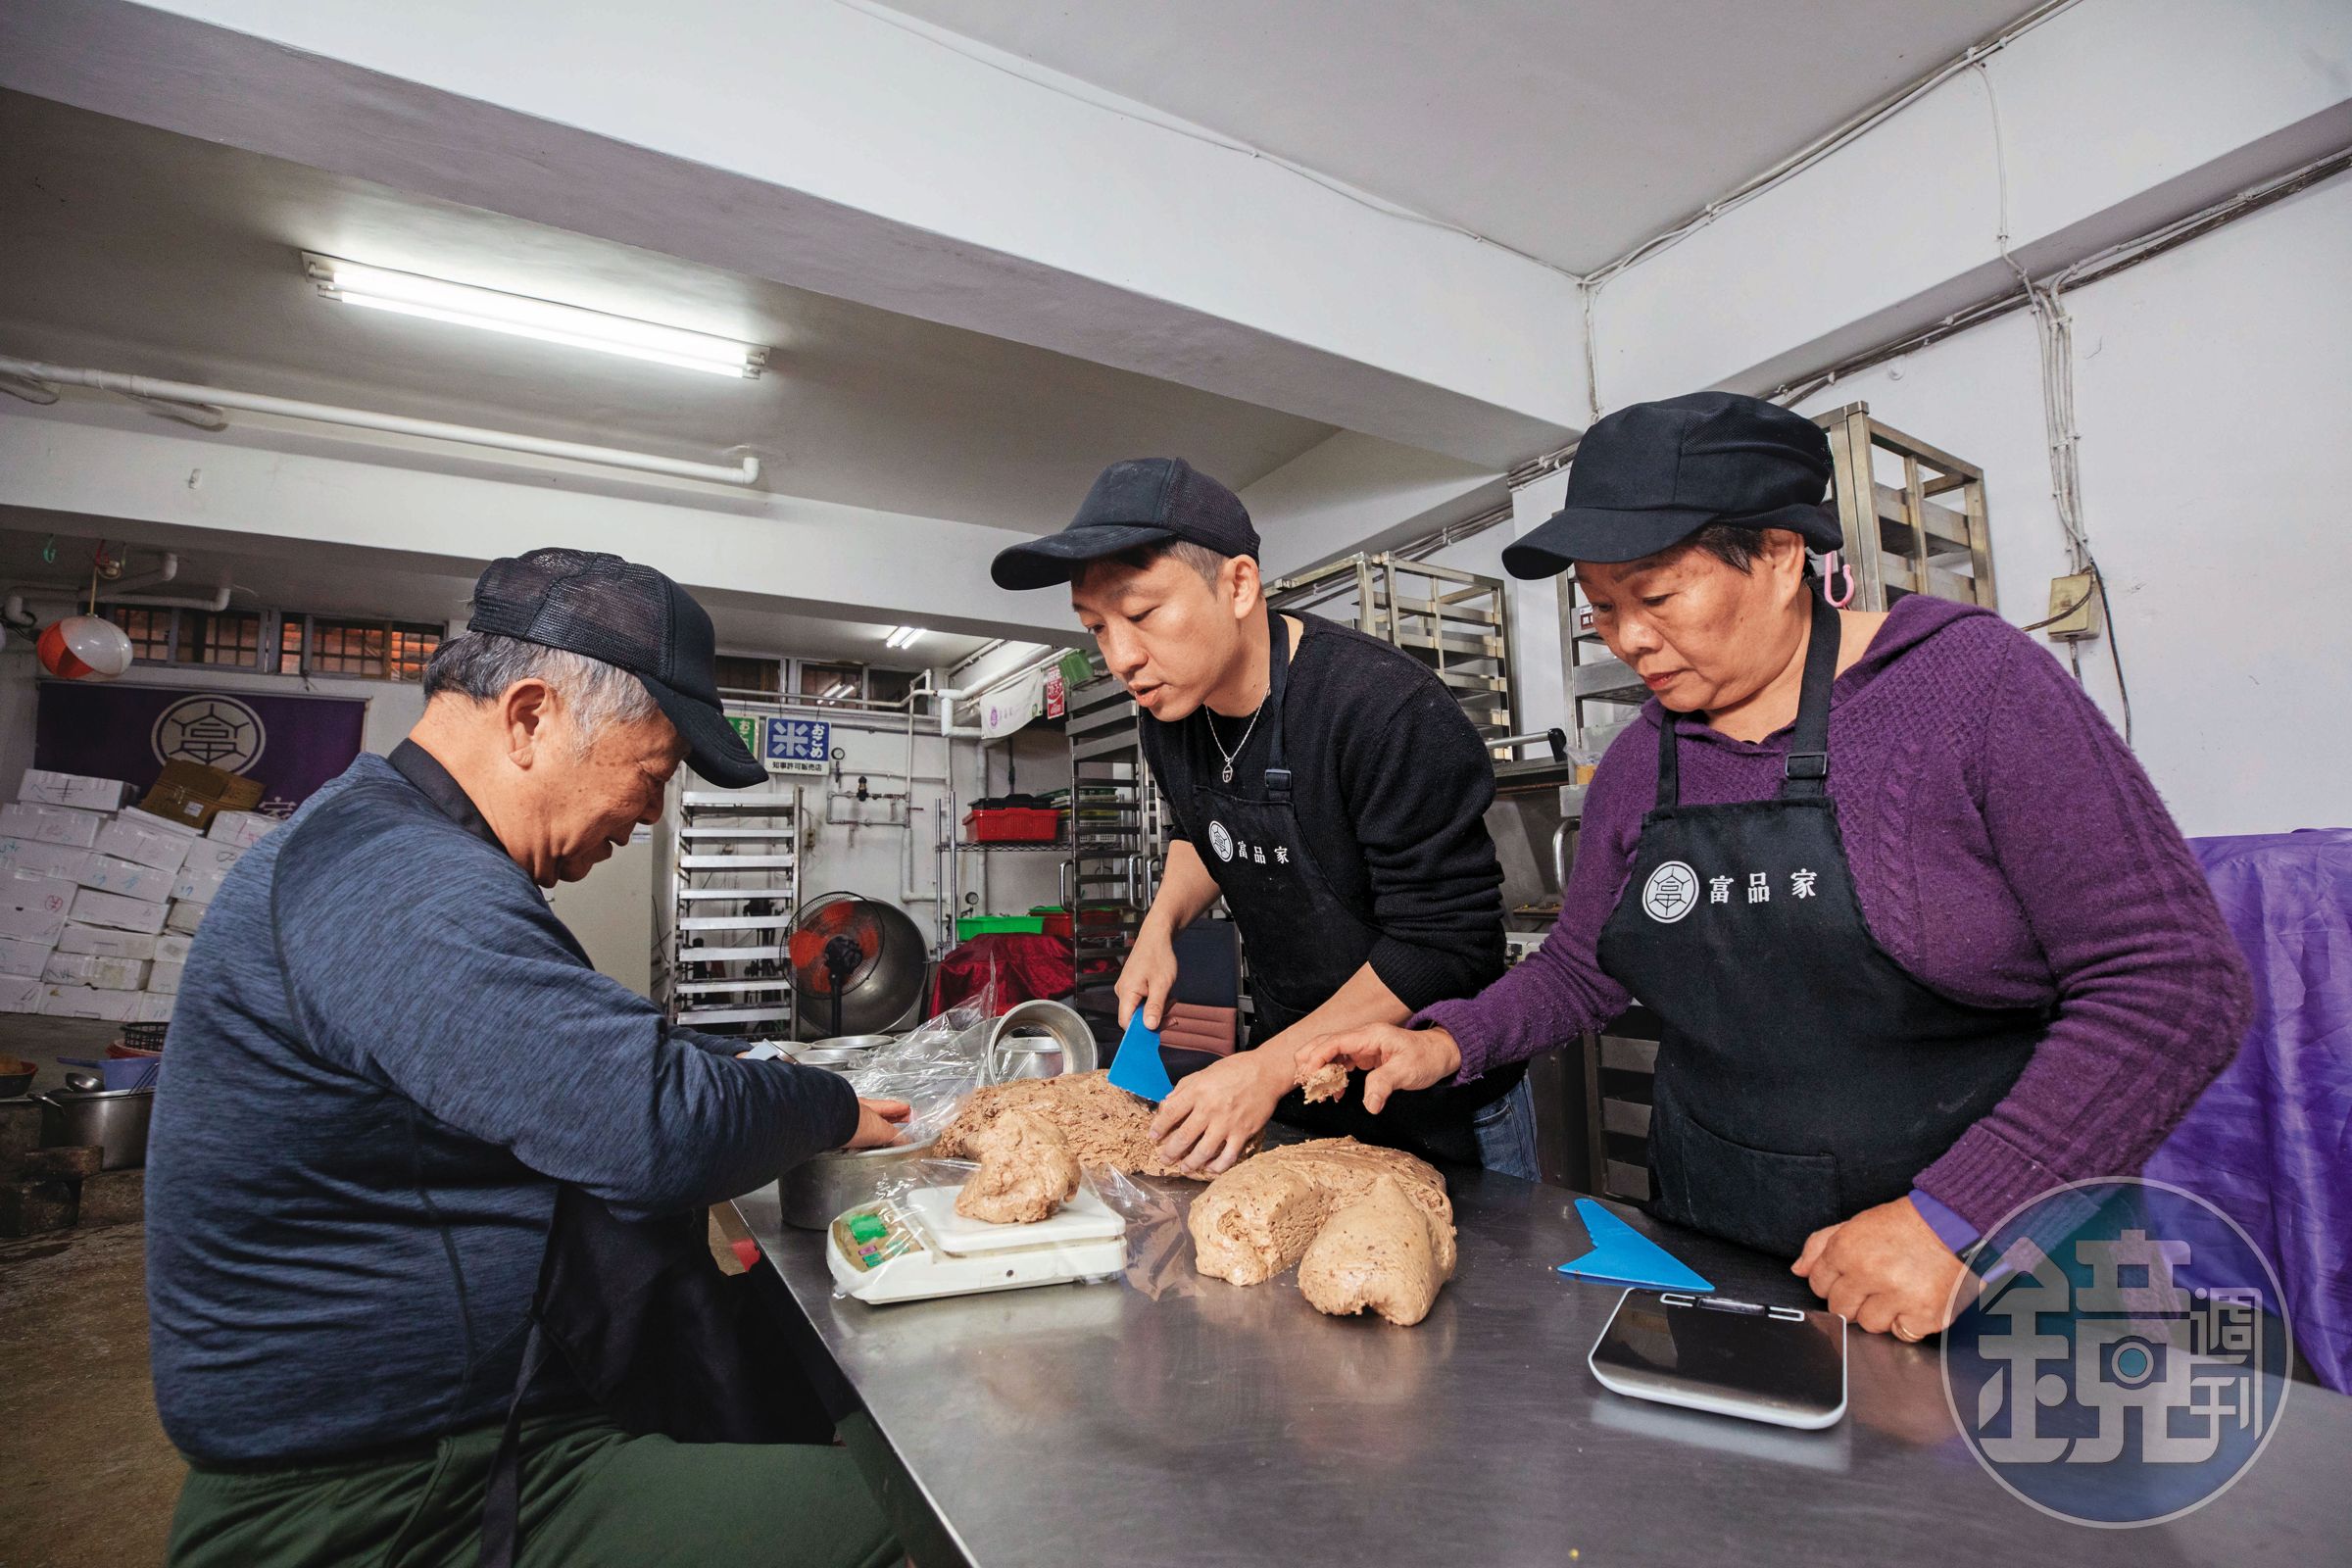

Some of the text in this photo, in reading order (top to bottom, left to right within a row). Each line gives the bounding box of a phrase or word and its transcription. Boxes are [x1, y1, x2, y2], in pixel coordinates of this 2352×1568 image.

[772, 721, 808, 757] 米
[810, 723, 825, 759] おこめ
[1238, 840, 1290, 864] 富品家
[1708, 868, 1818, 905] 富品家
